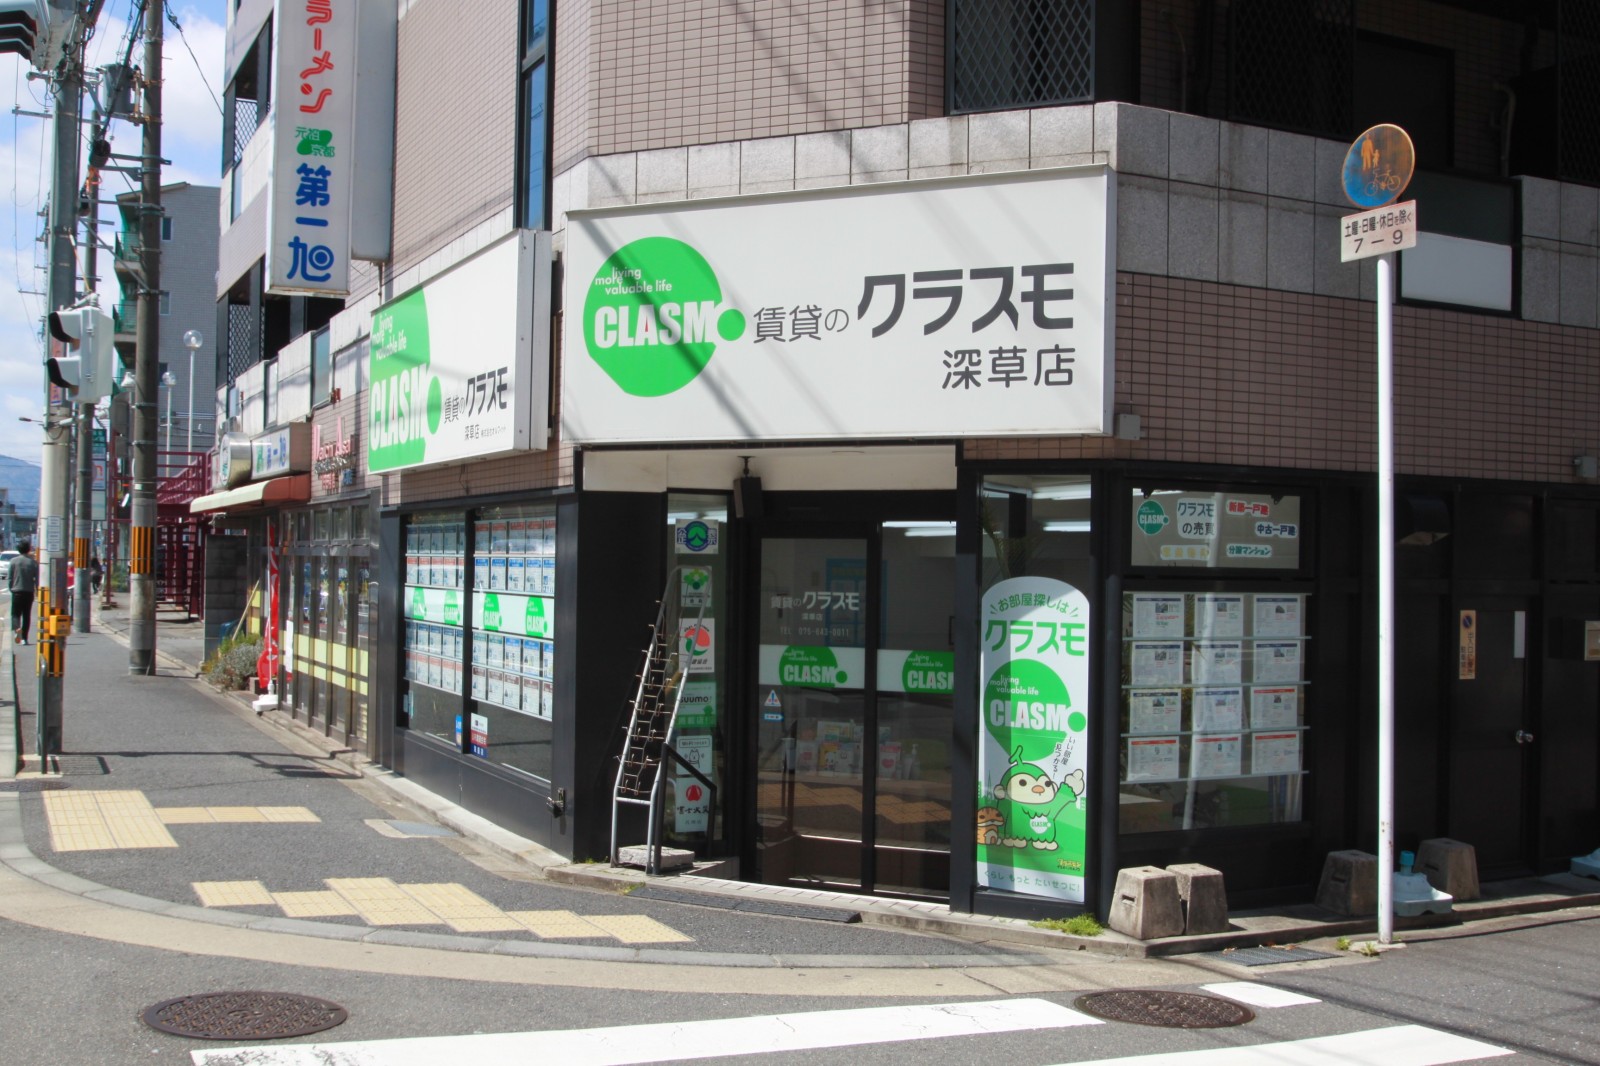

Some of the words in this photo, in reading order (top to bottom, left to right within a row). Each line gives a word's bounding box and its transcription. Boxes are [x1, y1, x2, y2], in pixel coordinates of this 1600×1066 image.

[286, 163, 335, 283] 第一旭
[594, 273, 623, 286] more
[612, 266, 641, 280] living
[605, 281, 653, 295] valuable
[655, 279, 673, 292] life
[942, 343, 1076, 390] 深草店
[1177, 502, 1215, 517] クラスモ
[997, 593, 1070, 614] お部屋探しは
[985, 619, 1086, 657] クラスモ
[997, 685, 1027, 695] valuable
[1027, 686, 1040, 696] life
[1009, 874, 1030, 885] もっと
